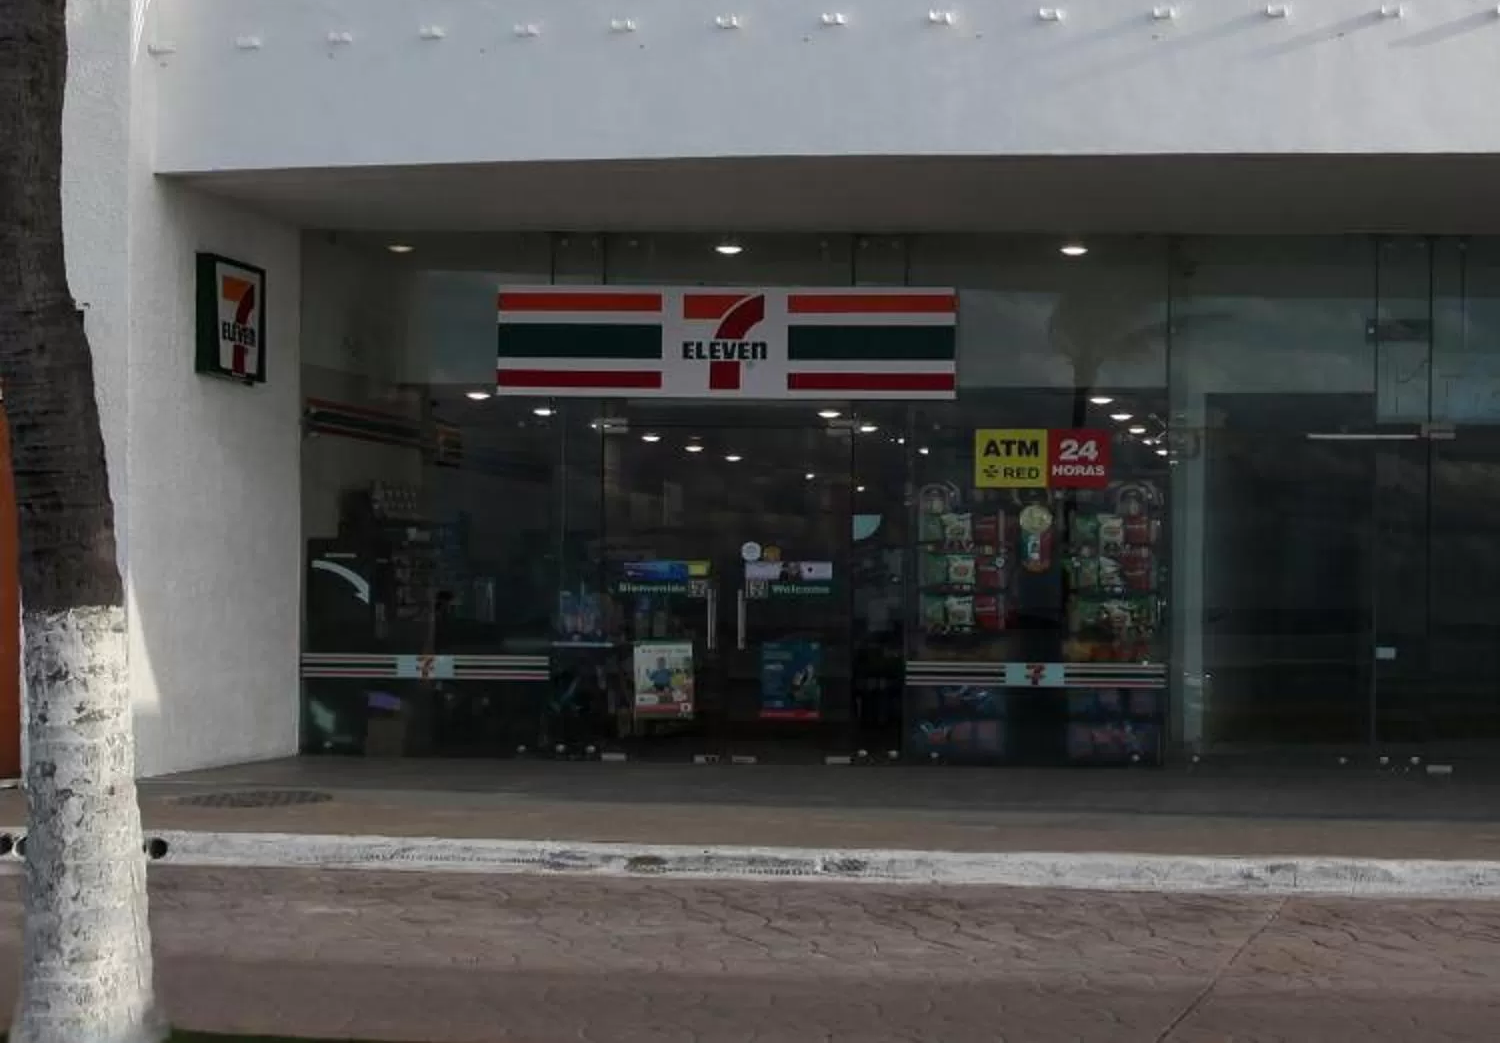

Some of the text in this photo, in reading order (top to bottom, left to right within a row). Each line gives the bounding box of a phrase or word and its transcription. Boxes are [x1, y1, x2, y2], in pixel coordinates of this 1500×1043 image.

[684, 293, 764, 389] 7
[983, 439, 1040, 457] ATM
[1059, 438, 1099, 462] 24
[1003, 466, 1040, 480] RED
[1051, 464, 1105, 477] HORAS
[771, 583, 831, 595] Welcome
